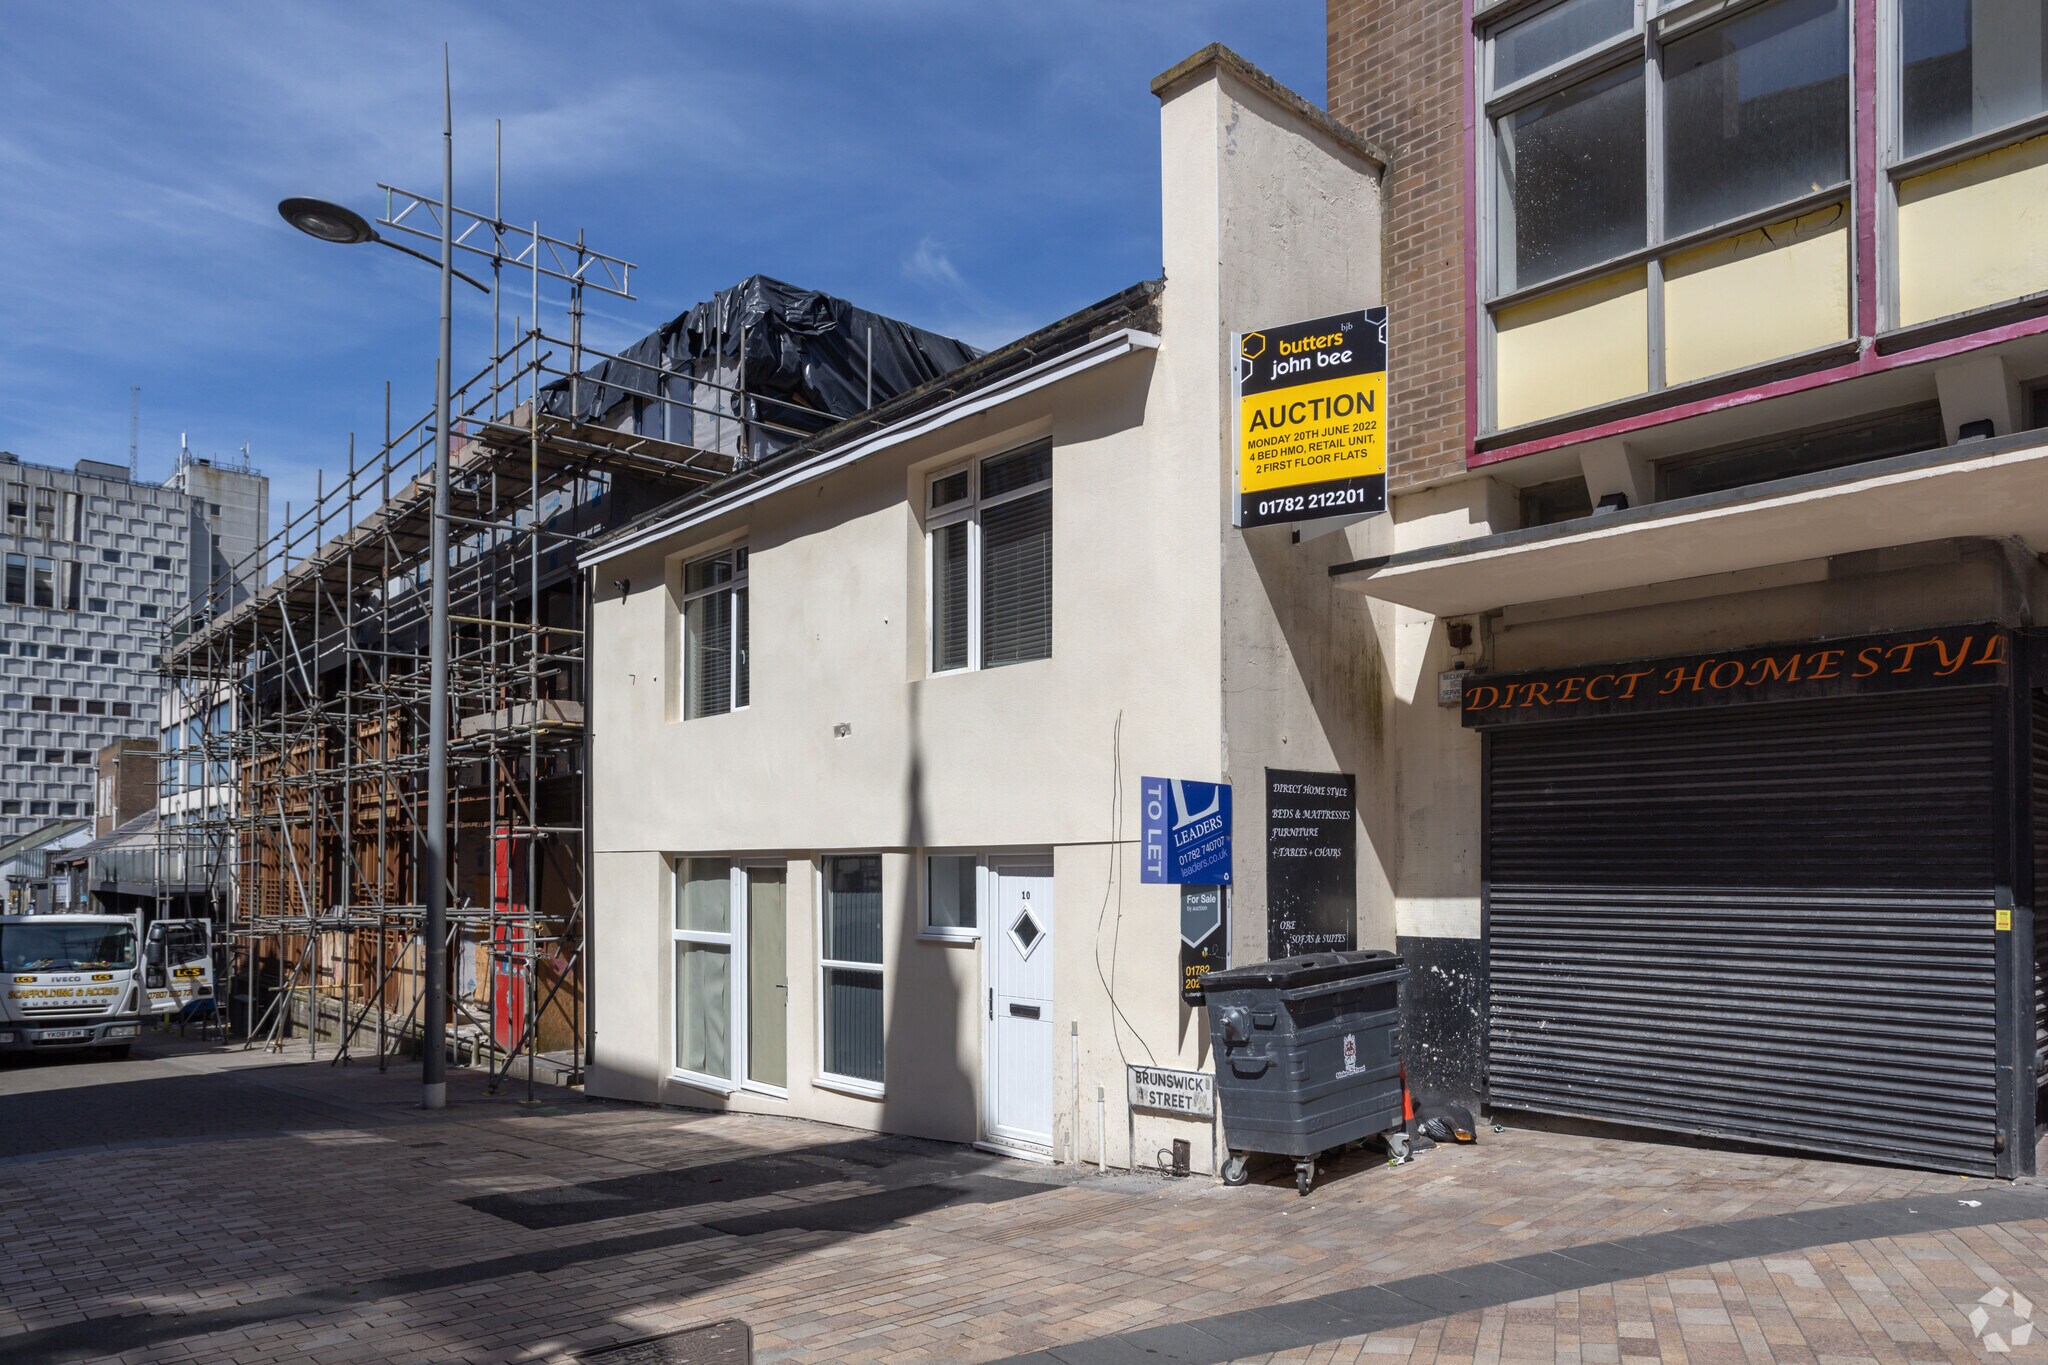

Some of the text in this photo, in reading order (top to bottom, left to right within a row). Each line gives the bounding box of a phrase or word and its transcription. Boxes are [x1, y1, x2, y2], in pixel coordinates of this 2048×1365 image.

[1341, 322, 1353, 332] bjb
[1279, 332, 1344, 356] butters
[1270, 350, 1353, 381] john bee
[1249, 389, 1375, 432] AUCTION
[1247, 420, 1377, 449] MONDAY 20TH JUNE 2022
[1249, 434, 1376, 461] 4 BED HMO, RETAIL UNIT,
[1256, 448, 1368, 474] 2 FIRST FLOOR FLATS
[1258, 488, 1364, 515] 01782 212201
[1465, 669, 1655, 711] DIRECT
[1658, 649, 1845, 695] HOME
[1272, 783, 1348, 798] DIRECT HOME STYLE
[1271, 808, 1351, 820] BEDS & MATTRESSES
[1147, 784, 1162, 877] TO LET
[1174, 815, 1223, 847] LEADERS
[1271, 827, 1319, 838] FURNITURE
[1178, 836, 1225, 865] 01782 740707
[1279, 846, 1308, 857] TABLES
[1314, 846, 1342, 857] CHAIRS
[1181, 848, 1229, 877] leaders.co.uk
[1021, 891, 1031, 900] 10
[1186, 894, 1200, 904] For
[1200, 894, 1216, 904] Sale
[1291, 933, 1347, 945] SOFAS & SUITES
[177, 968, 200, 977] LCS
[8, 986, 119, 999] SCAFFOLDING & ACCESS
[22, 998, 108, 1006] EUROCARGO
[1135, 1071, 1204, 1092] BRUNSWICK
[1149, 1090, 1193, 1109] STREET
